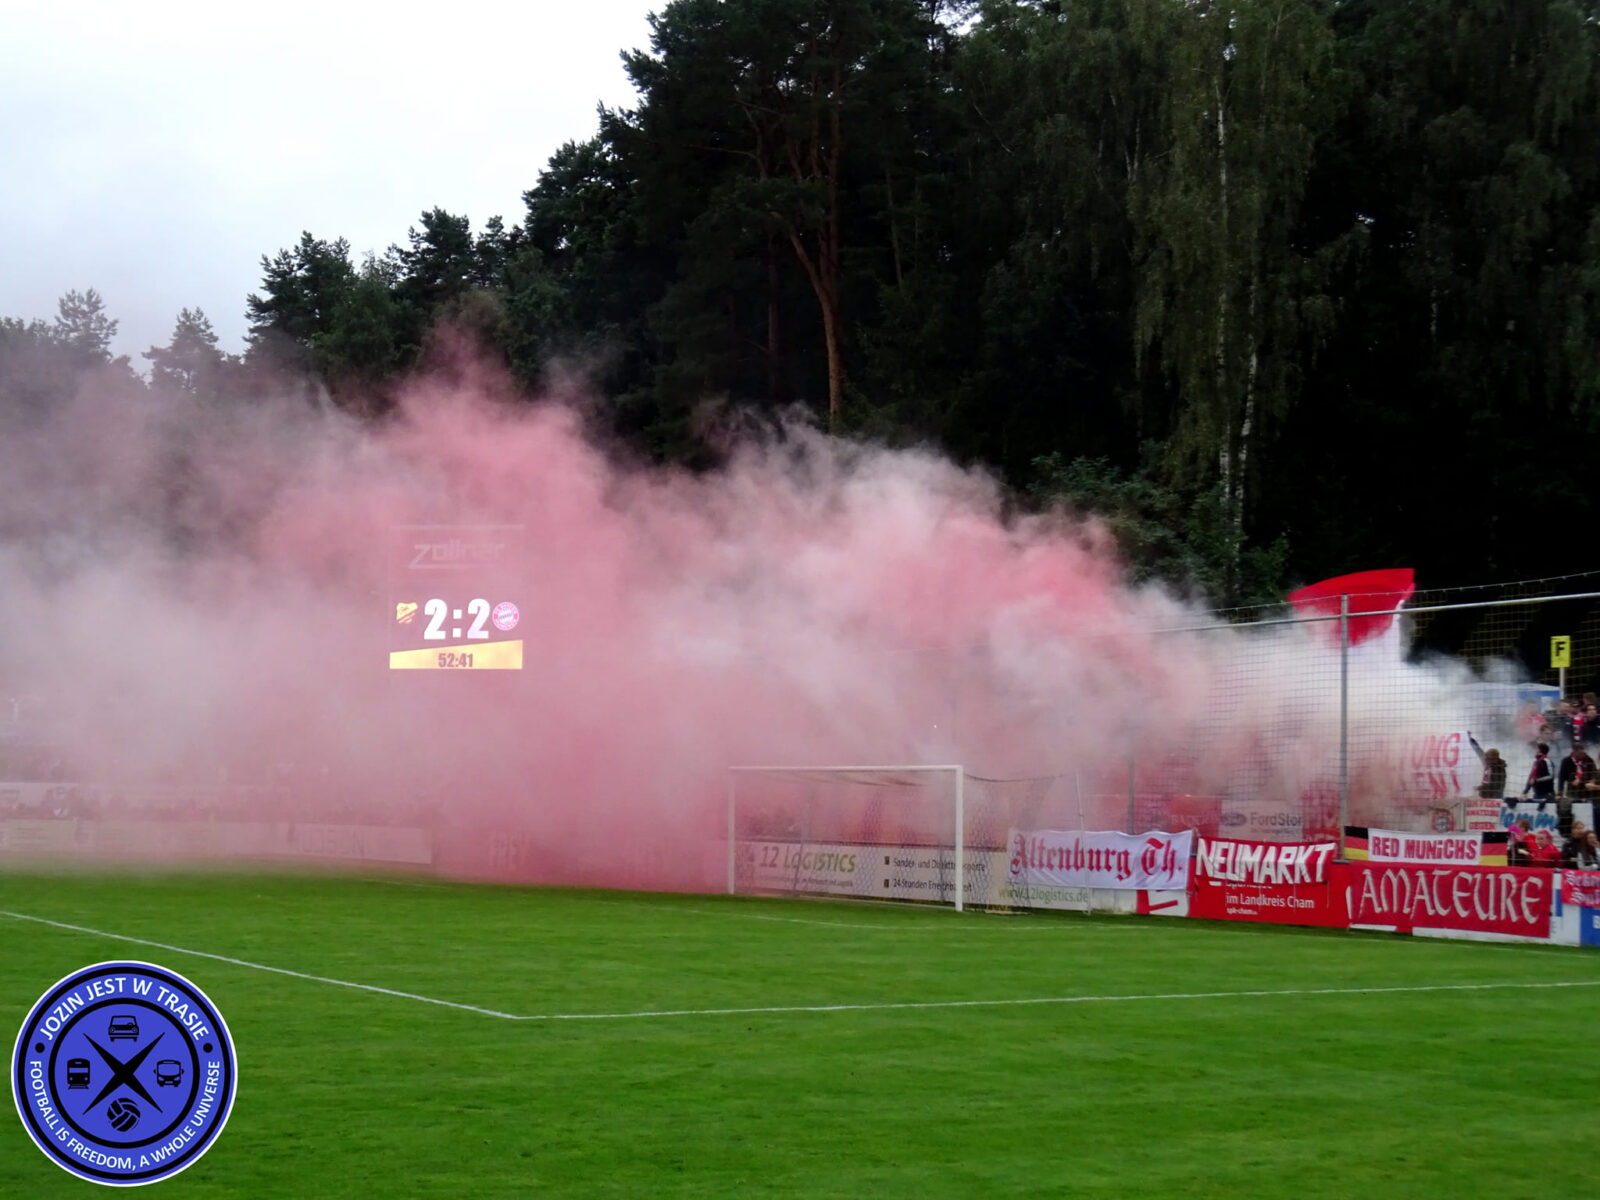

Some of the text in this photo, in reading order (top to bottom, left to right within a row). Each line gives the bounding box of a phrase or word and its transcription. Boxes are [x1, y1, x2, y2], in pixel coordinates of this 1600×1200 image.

[424, 598, 490, 639] 2:2
[438, 653, 474, 668] 52:41
[1555, 641, 1566, 657] F
[760, 846, 856, 873] 12 LOGISTICS
[1010, 834, 1131, 881] Altenburg
[1372, 836, 1399, 857] RED
[1196, 838, 1336, 884] NEUMARKT
[1226, 892, 1315, 908] im Landkreis Cham
[1358, 868, 1543, 925] AMATEURE
